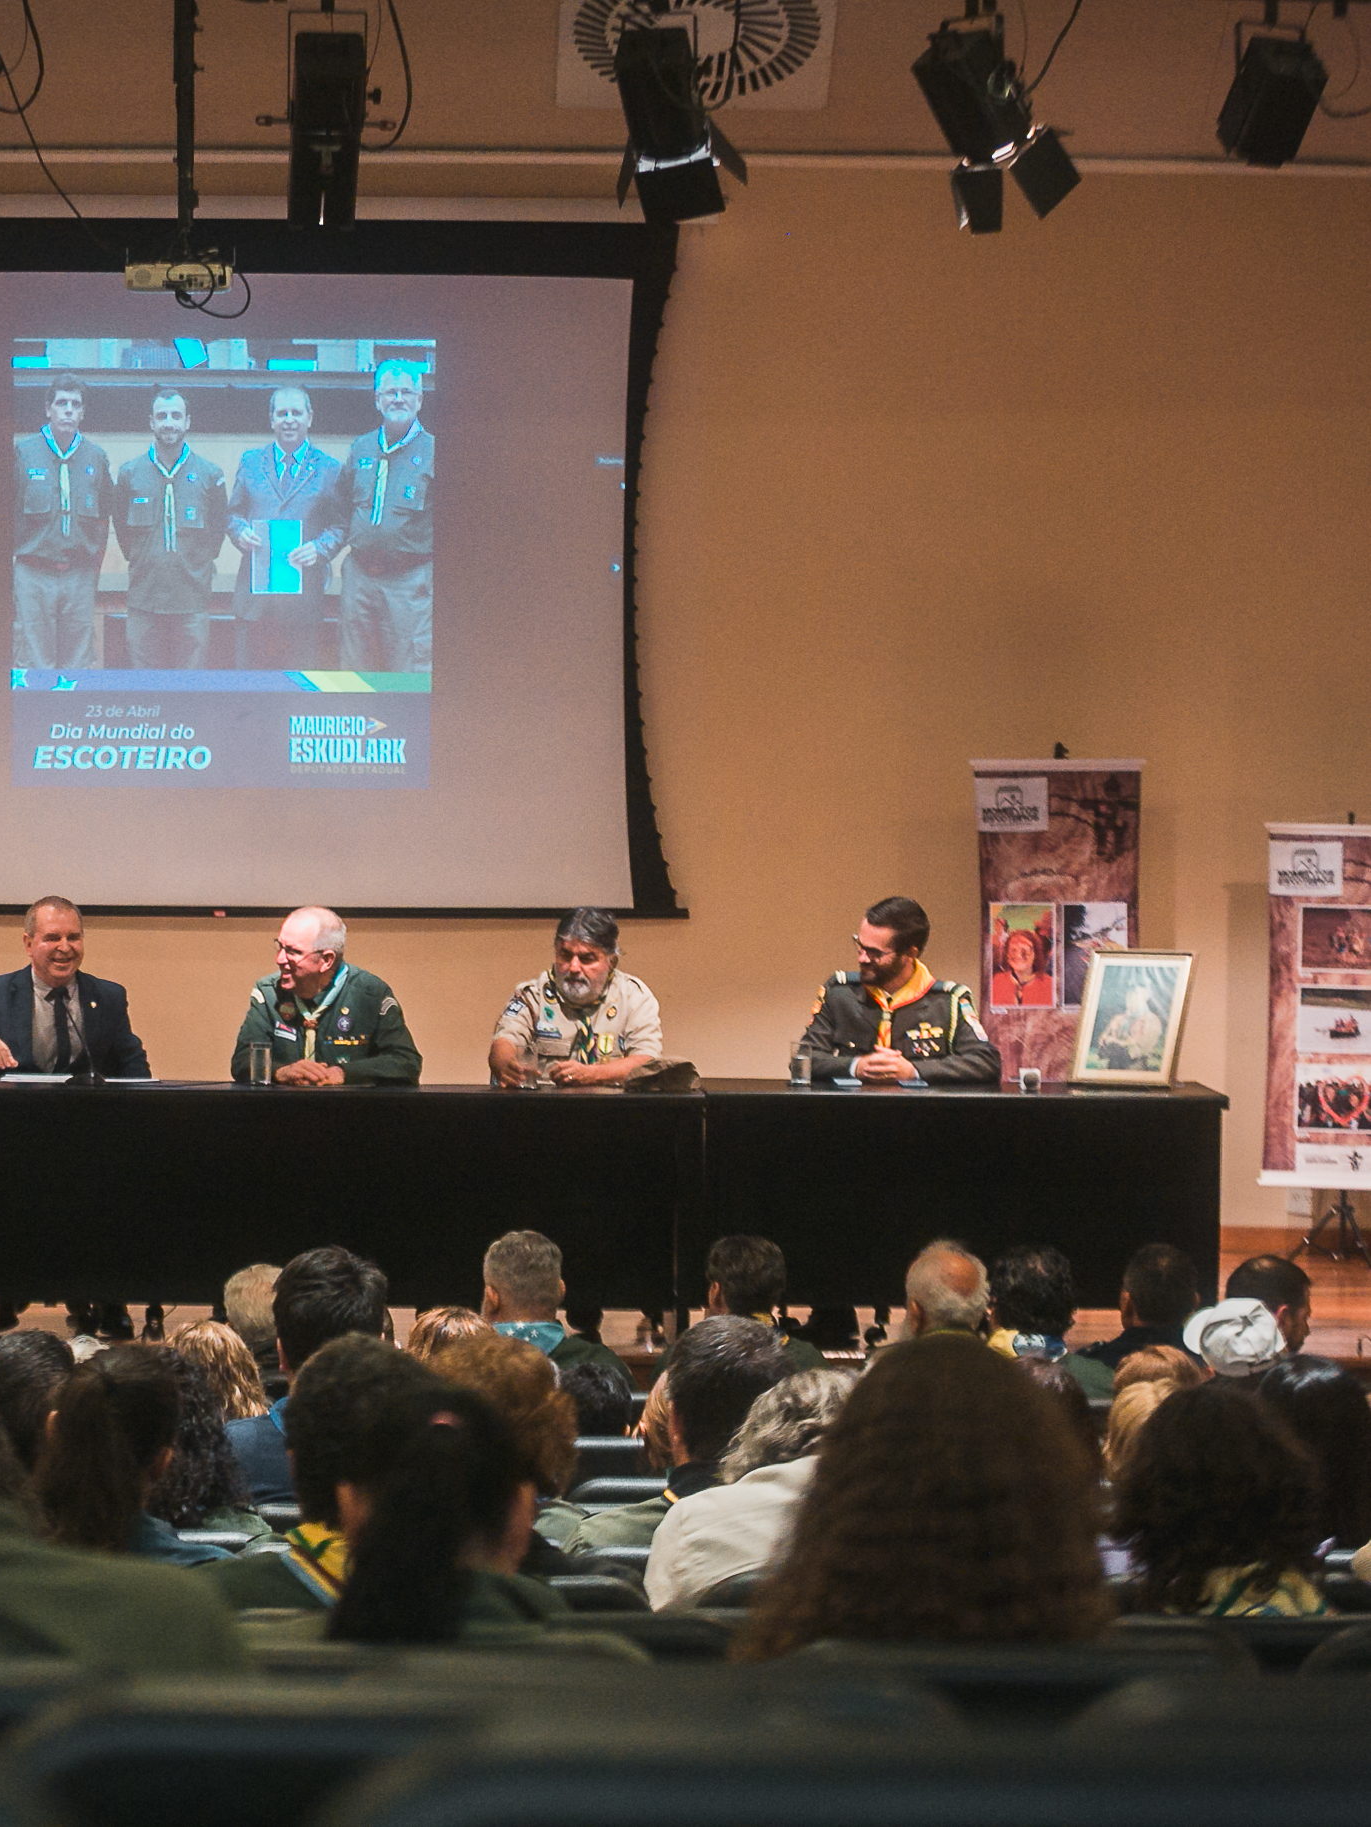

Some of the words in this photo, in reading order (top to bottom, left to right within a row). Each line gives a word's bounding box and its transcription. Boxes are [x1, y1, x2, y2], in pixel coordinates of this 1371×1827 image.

[85, 705, 102, 718] 23
[105, 705, 124, 718] de
[126, 705, 161, 718] Abril
[50, 722, 83, 740] Dia
[87, 723, 166, 740] Mundial
[169, 723, 196, 740] do
[290, 715, 367, 736] MAURICIO
[33, 745, 212, 770] ESCOTEIRO
[290, 737, 407, 764] ESKUDLARK
[290, 765, 348, 774] DEPUTADO
[351, 765, 406, 775] ESTADUAL
